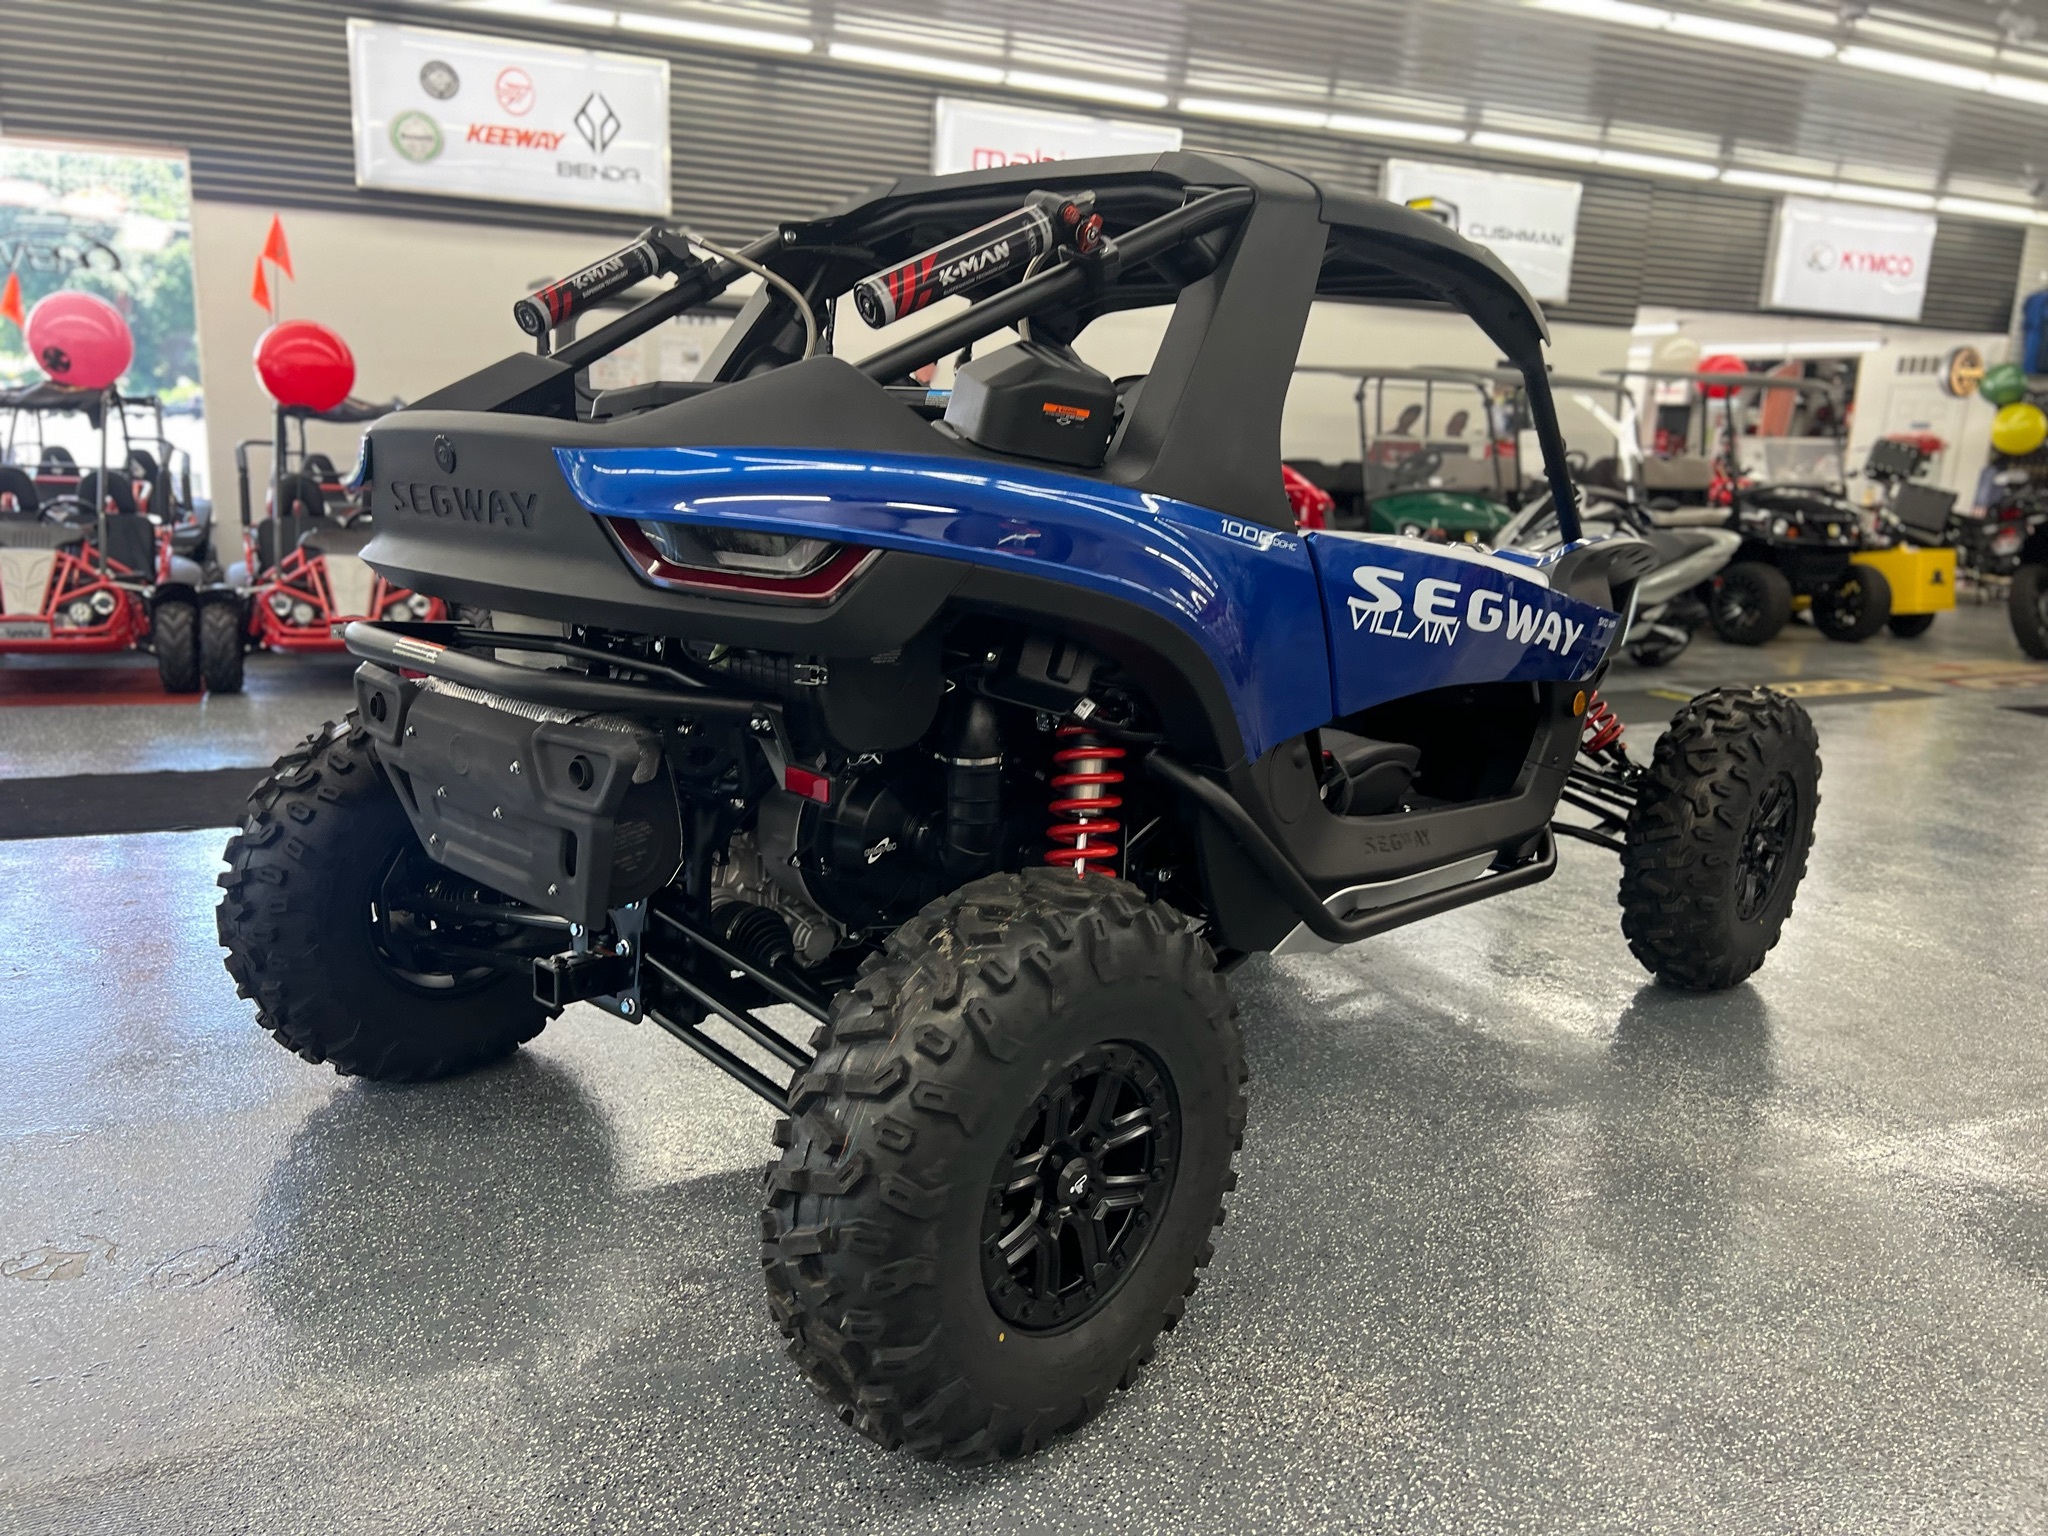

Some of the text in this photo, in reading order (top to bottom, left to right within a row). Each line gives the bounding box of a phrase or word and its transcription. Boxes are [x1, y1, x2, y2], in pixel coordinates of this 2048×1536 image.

[466, 123, 566, 151] KEEWAY
[1468, 223, 1564, 247] CUSHMAN
[1840, 251, 1914, 277] KYMCO
[391, 480, 537, 528] SEGWAY
[1347, 565, 1584, 656] SEGWAY
[1350, 604, 1460, 646] VILLAIN
[1364, 827, 1431, 855] SEGWAY
